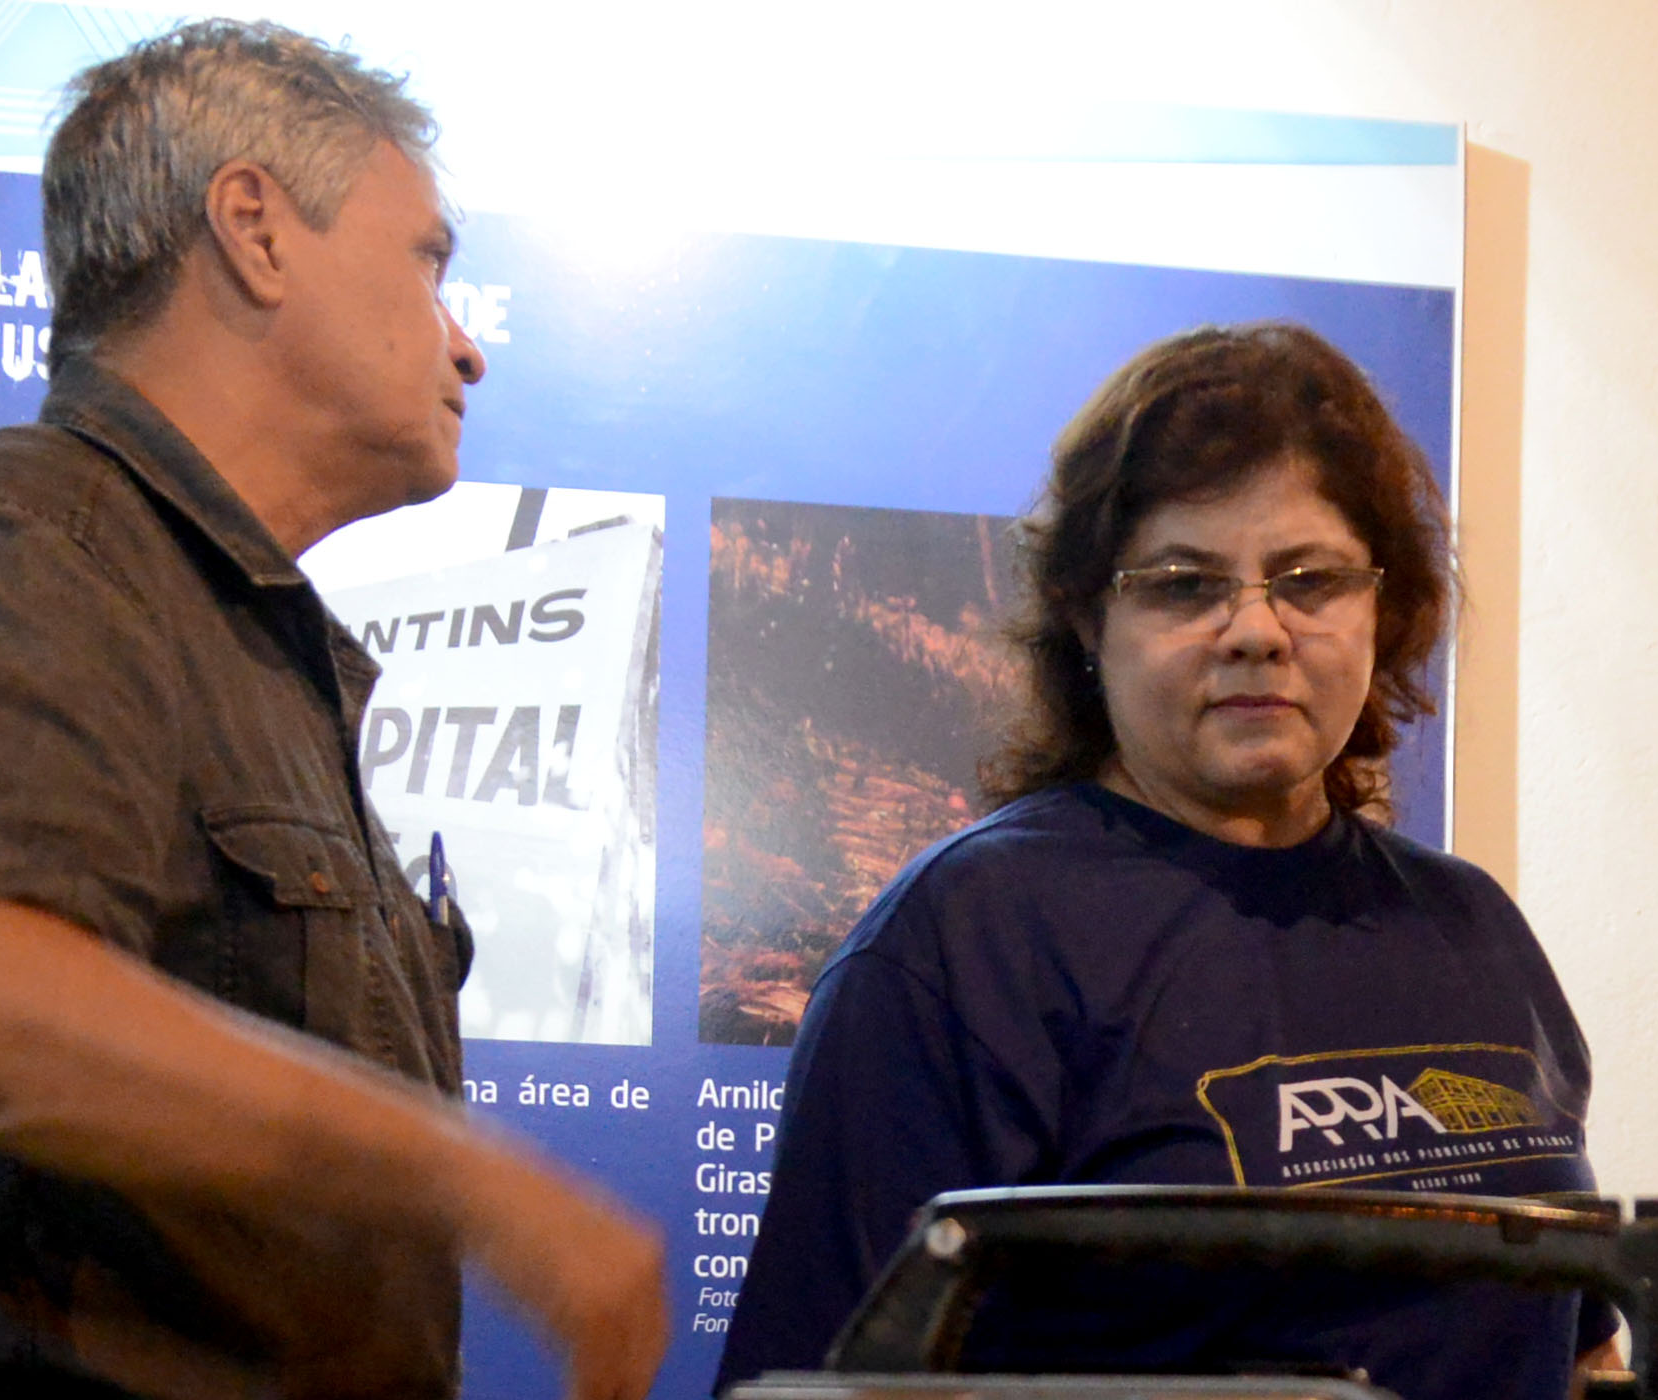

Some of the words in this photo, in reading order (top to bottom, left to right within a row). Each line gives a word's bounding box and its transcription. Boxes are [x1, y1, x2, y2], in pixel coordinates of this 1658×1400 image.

[344, 588, 587, 654] NTINS
[518, 1074, 590, 1107] área
[610, 1079, 650, 1109] de
[696, 1120, 735, 1151] de
[755, 1122, 776, 1152] P
[1502, 1138, 1521, 1151] DE
[695, 1163, 773, 1194] Giras
[694, 1208, 760, 1236] tron
